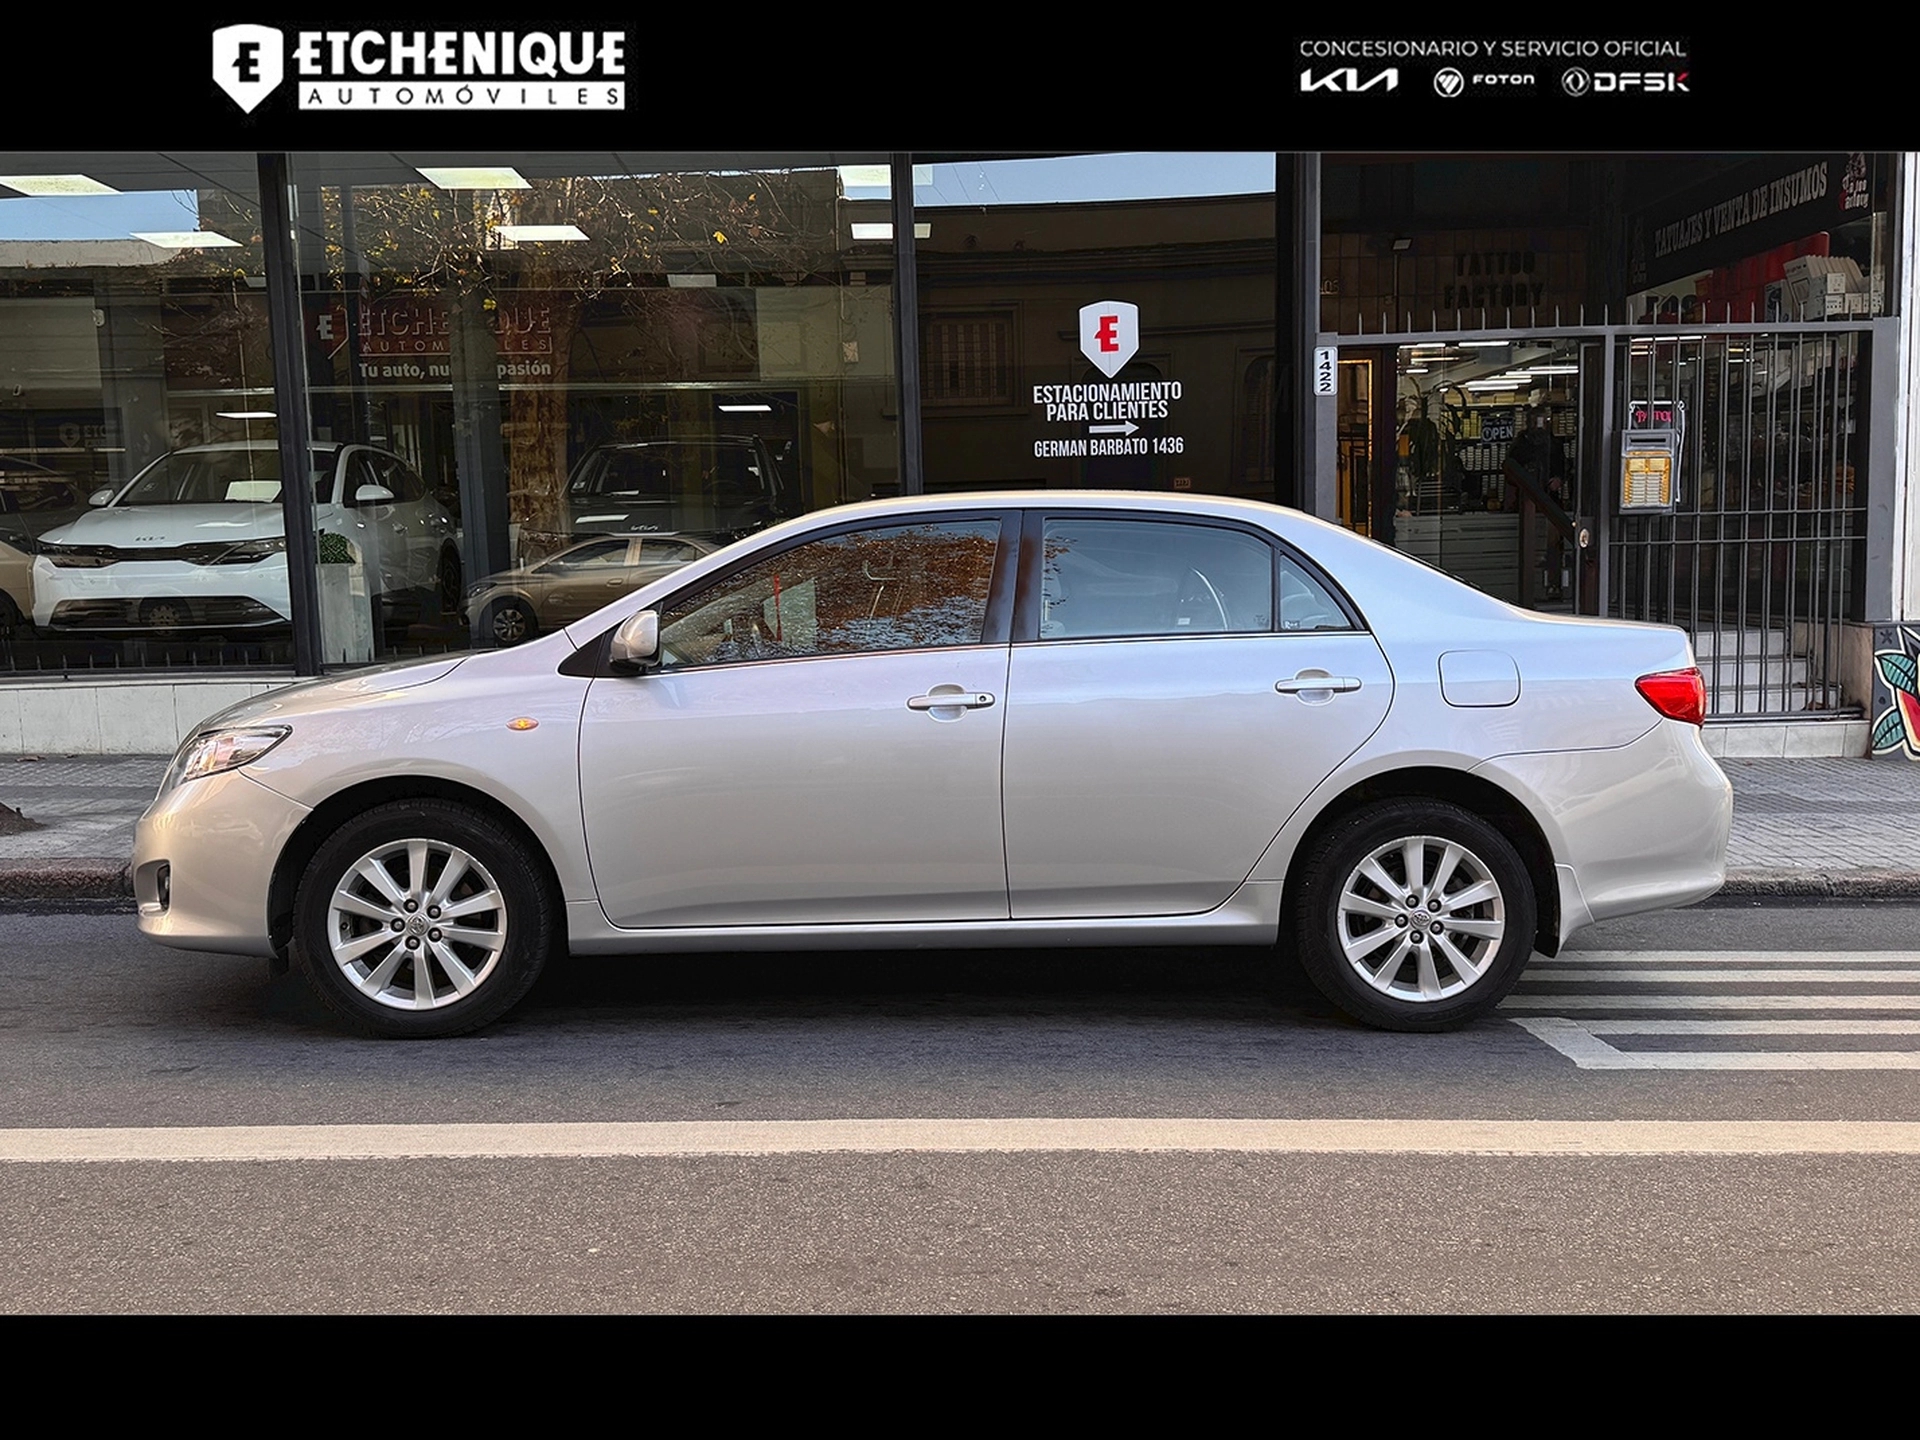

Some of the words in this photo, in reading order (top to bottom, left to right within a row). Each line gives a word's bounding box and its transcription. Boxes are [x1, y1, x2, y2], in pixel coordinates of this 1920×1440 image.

[1655, 209, 1703, 258] TATUAJES
[1712, 190, 1750, 234] VENTA
[1752, 182, 1768, 221] DE
[1769, 161, 1828, 214] INSUMOS
[1456, 252, 1536, 276] TATTOO
[1444, 283, 1544, 309] FACTORY
[359, 363, 378, 376] Tu
[382, 362, 426, 379] auto,
[497, 360, 551, 379] pasión
[1319, 351, 1332, 392] 1422
[1033, 381, 1182, 404] ESTACIONAMIENTO
[1046, 403, 1089, 422] PARA
[1093, 400, 1168, 420] CLIENTES
[1482, 426, 1513, 442] OPEN
[1034, 439, 1087, 457] GERMAN
[1090, 437, 1148, 456] BARBATO
[1152, 436, 1184, 454] 1436
